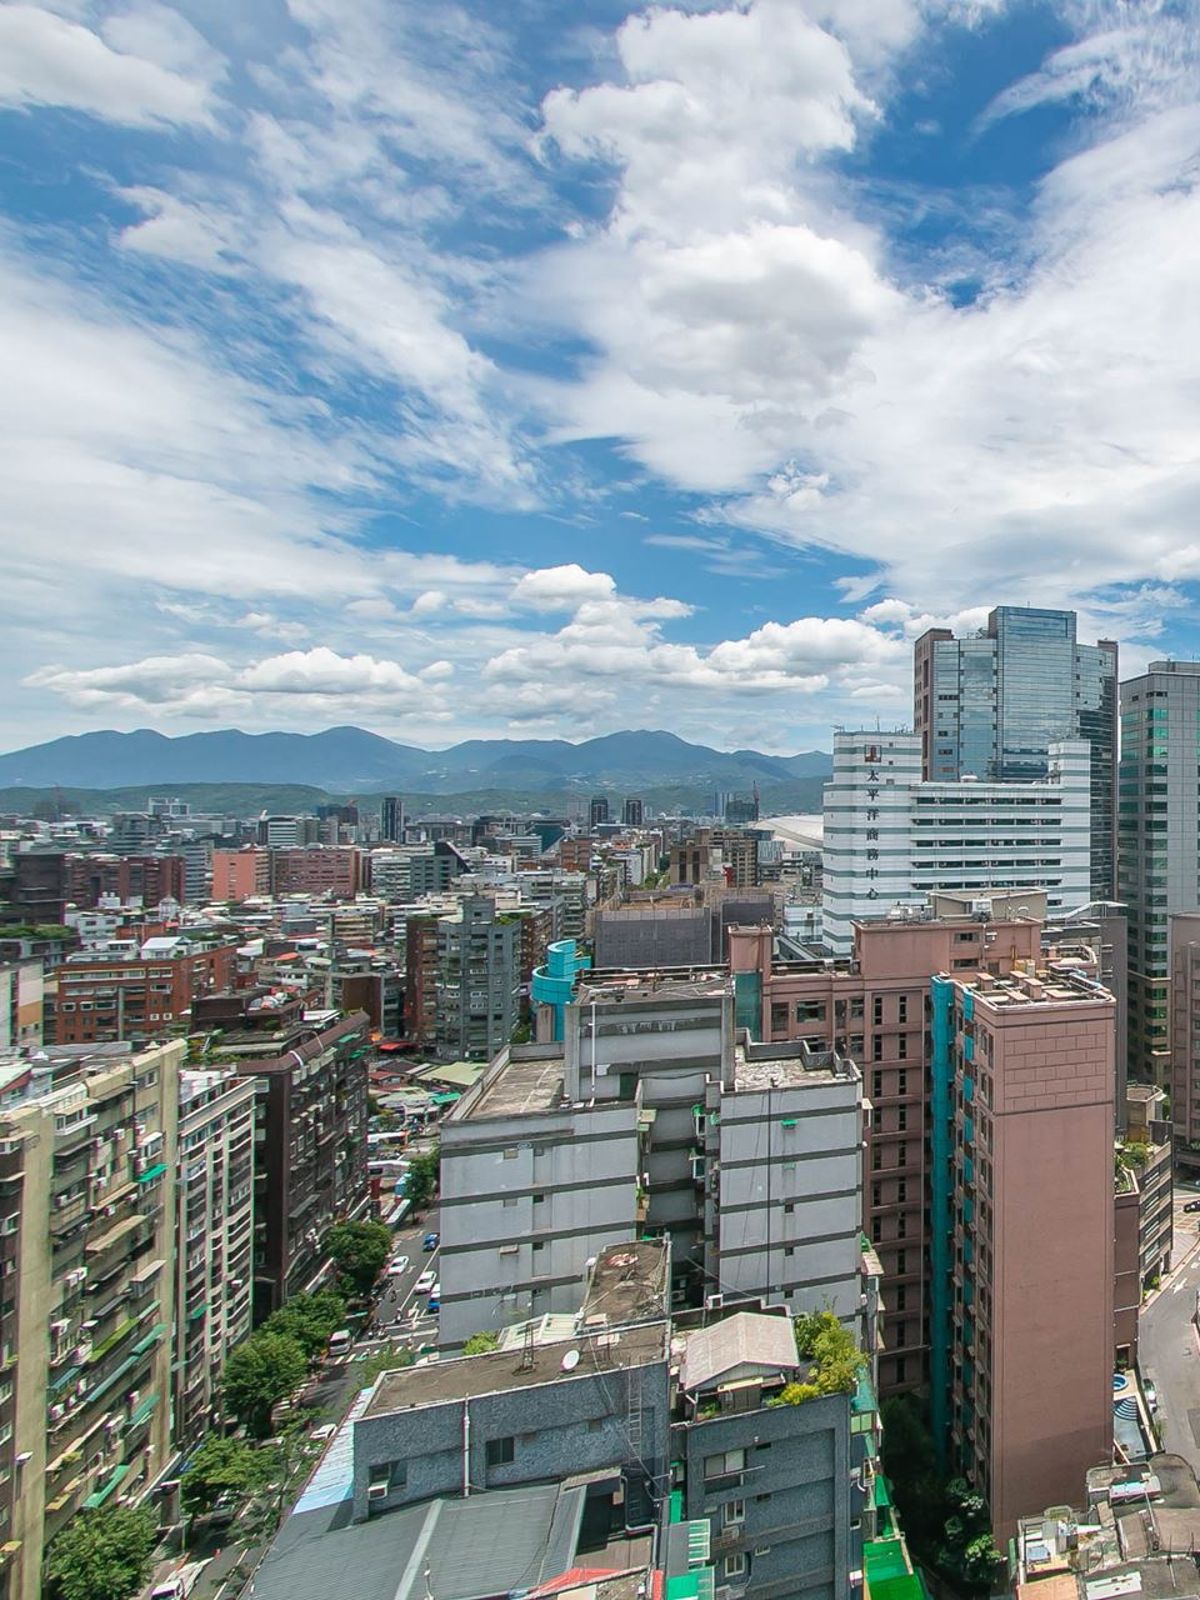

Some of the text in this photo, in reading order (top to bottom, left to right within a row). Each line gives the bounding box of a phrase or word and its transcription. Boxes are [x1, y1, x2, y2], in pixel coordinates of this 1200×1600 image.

[866, 770, 880, 900] 太平洋商務中心
